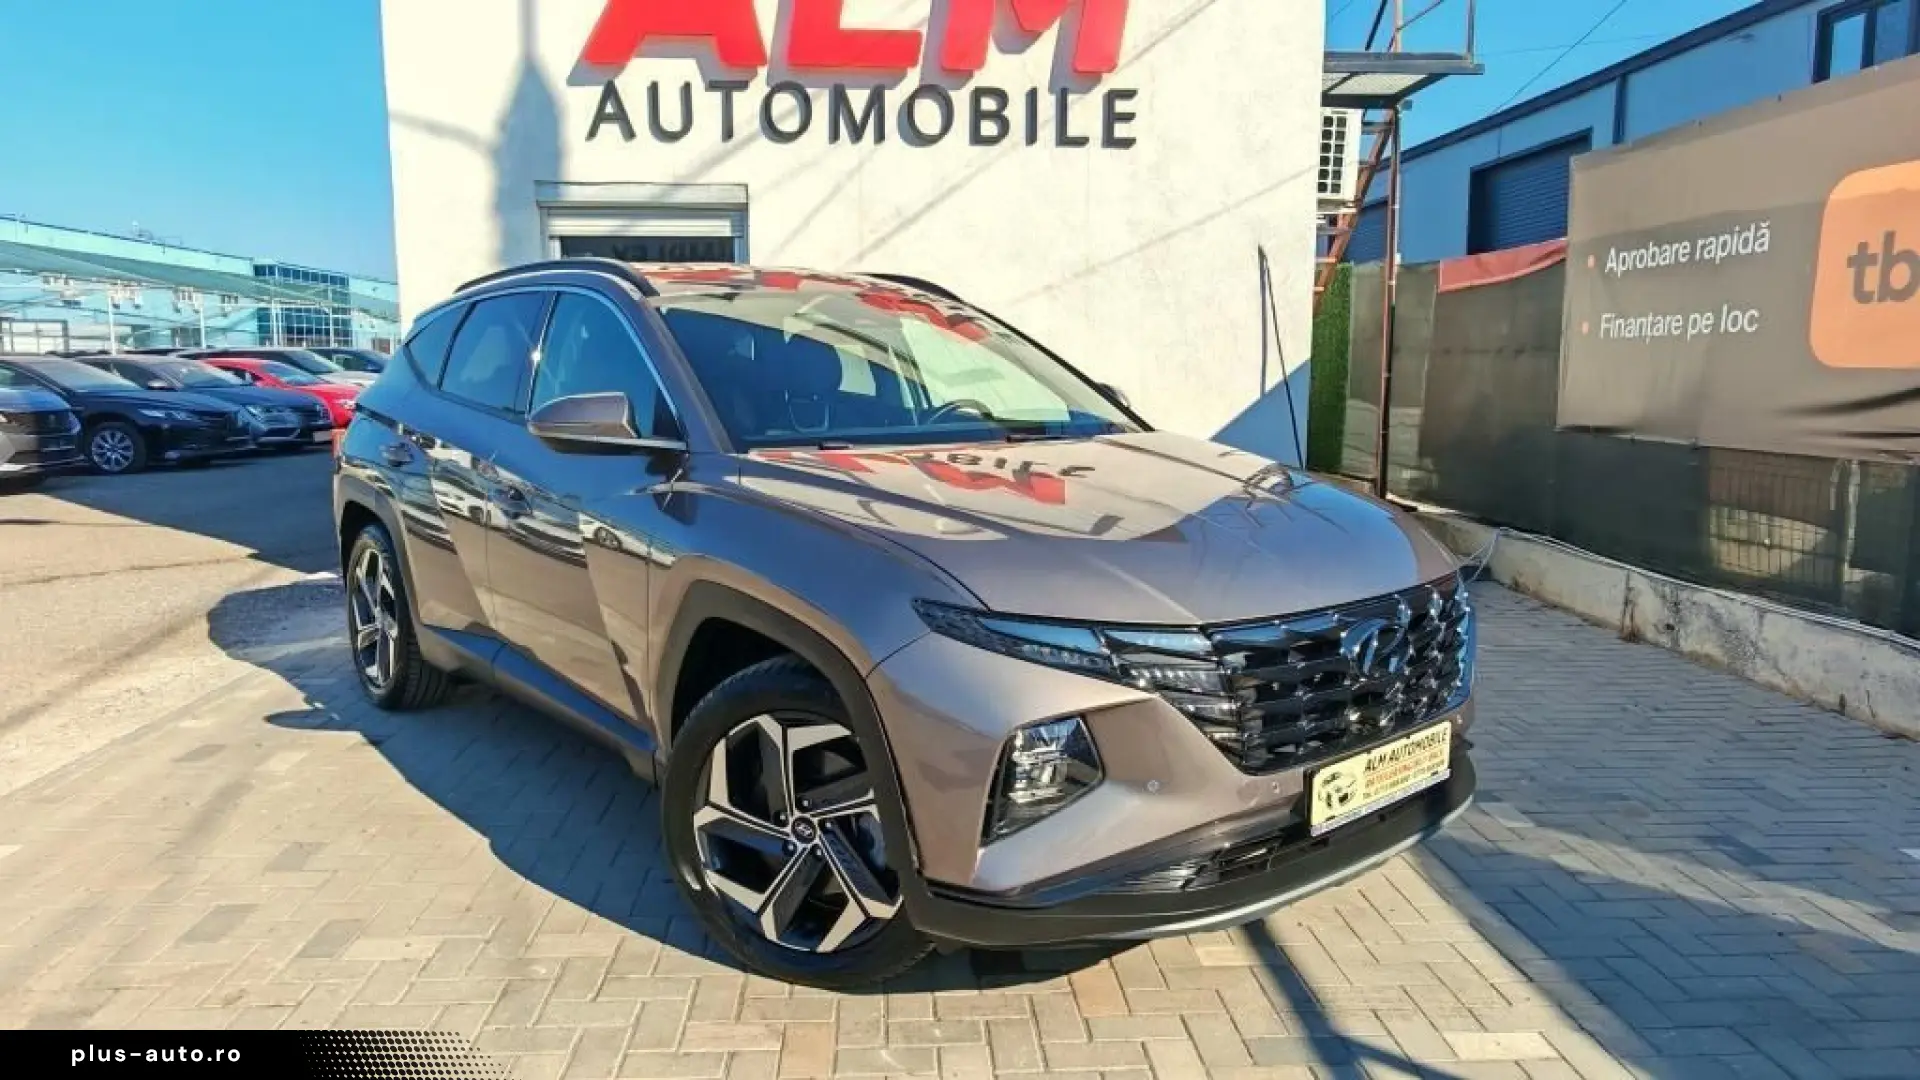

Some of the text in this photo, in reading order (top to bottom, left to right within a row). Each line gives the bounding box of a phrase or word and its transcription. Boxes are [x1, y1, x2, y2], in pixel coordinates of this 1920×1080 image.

[585, 79, 1139, 149] AUTOMOBILE
[1604, 221, 1771, 278] Aprobare rapidă
[1599, 304, 1760, 344] Finanțare pe loc
